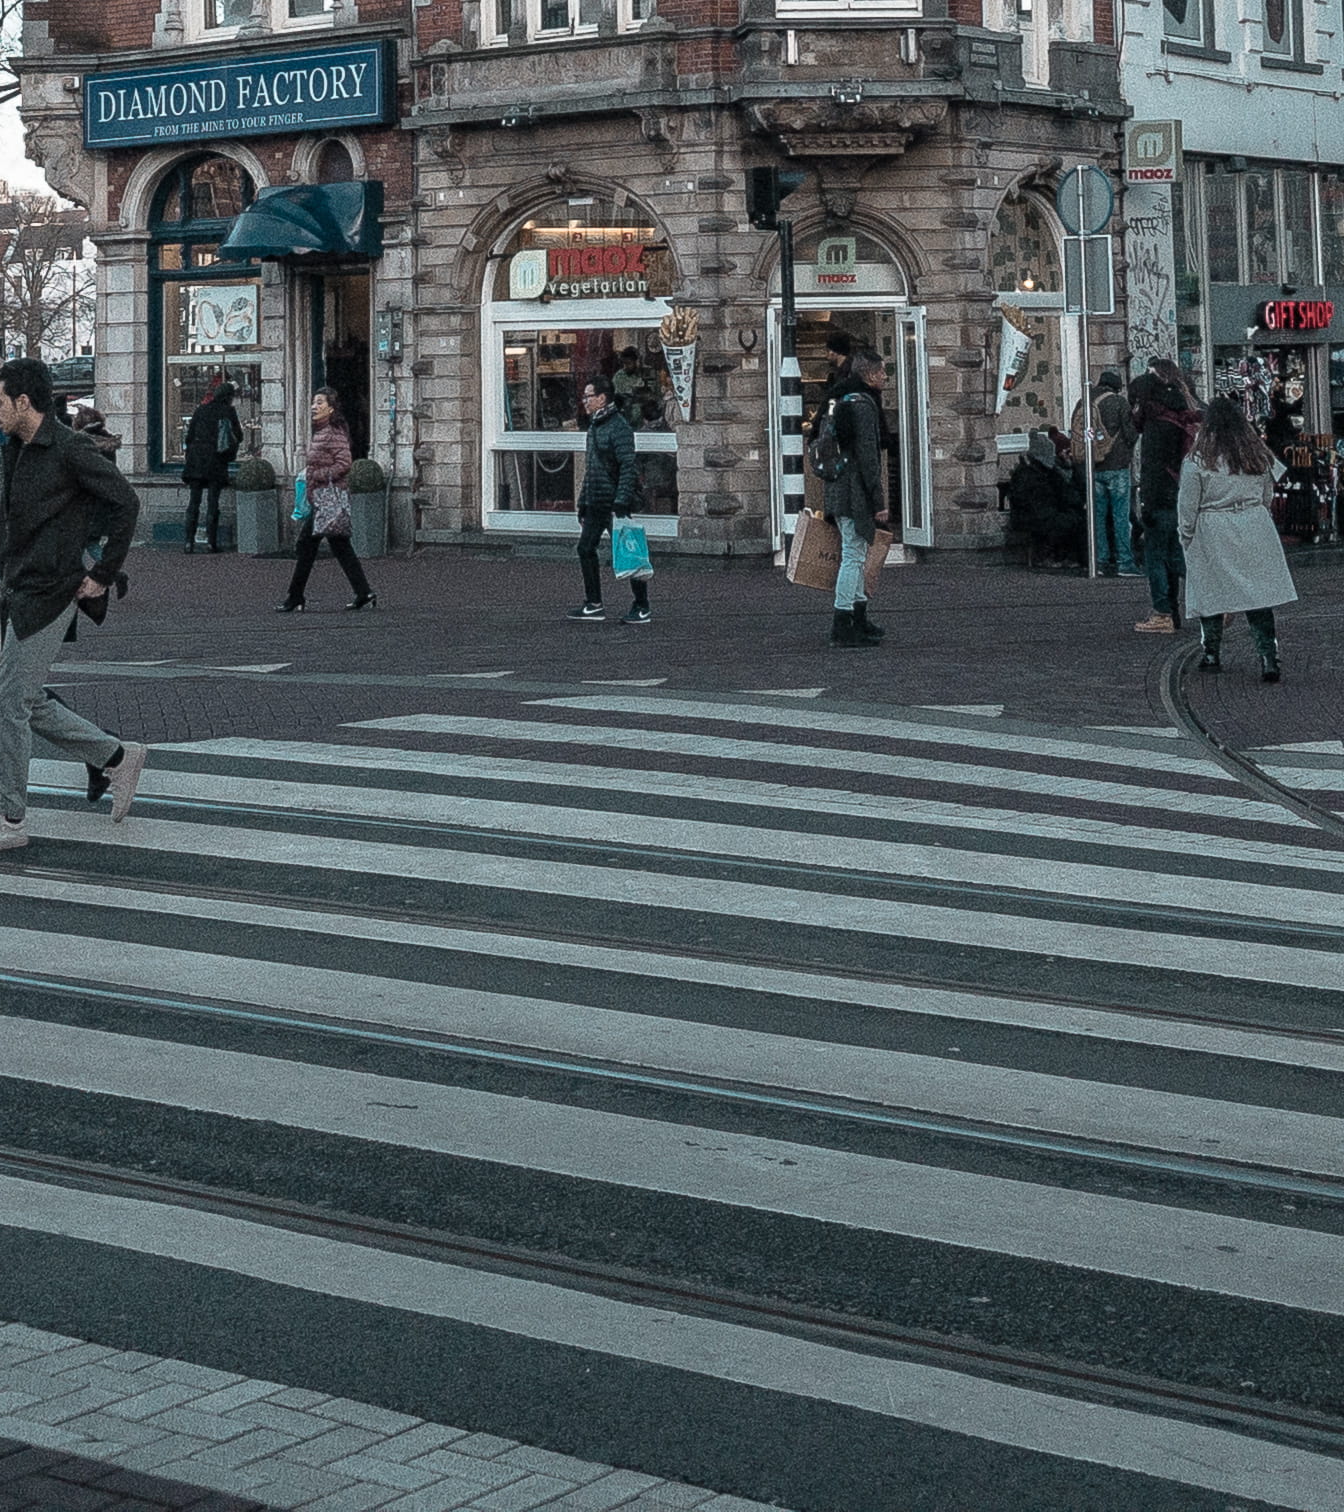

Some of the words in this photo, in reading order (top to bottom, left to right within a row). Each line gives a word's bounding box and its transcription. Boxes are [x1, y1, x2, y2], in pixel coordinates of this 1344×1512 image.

[98, 79, 226, 122] DIAMOND
[236, 63, 368, 109] FACTORY
[154, 124, 179, 137] FROM
[181, 122, 199, 134] THE
[201, 120, 225, 133] MINE
[226, 118, 240, 130] TO
[240, 116, 266, 129] YOUR
[268, 112, 305, 126] FINGER
[1128, 168, 1174, 180] maoz
[549, 245, 646, 276] maoz
[549, 277, 649, 297] vegetarian
[818, 273, 857, 284] maoz
[1265, 301, 1296, 330] GIFT
[1299, 300, 1335, 329] SHOP
